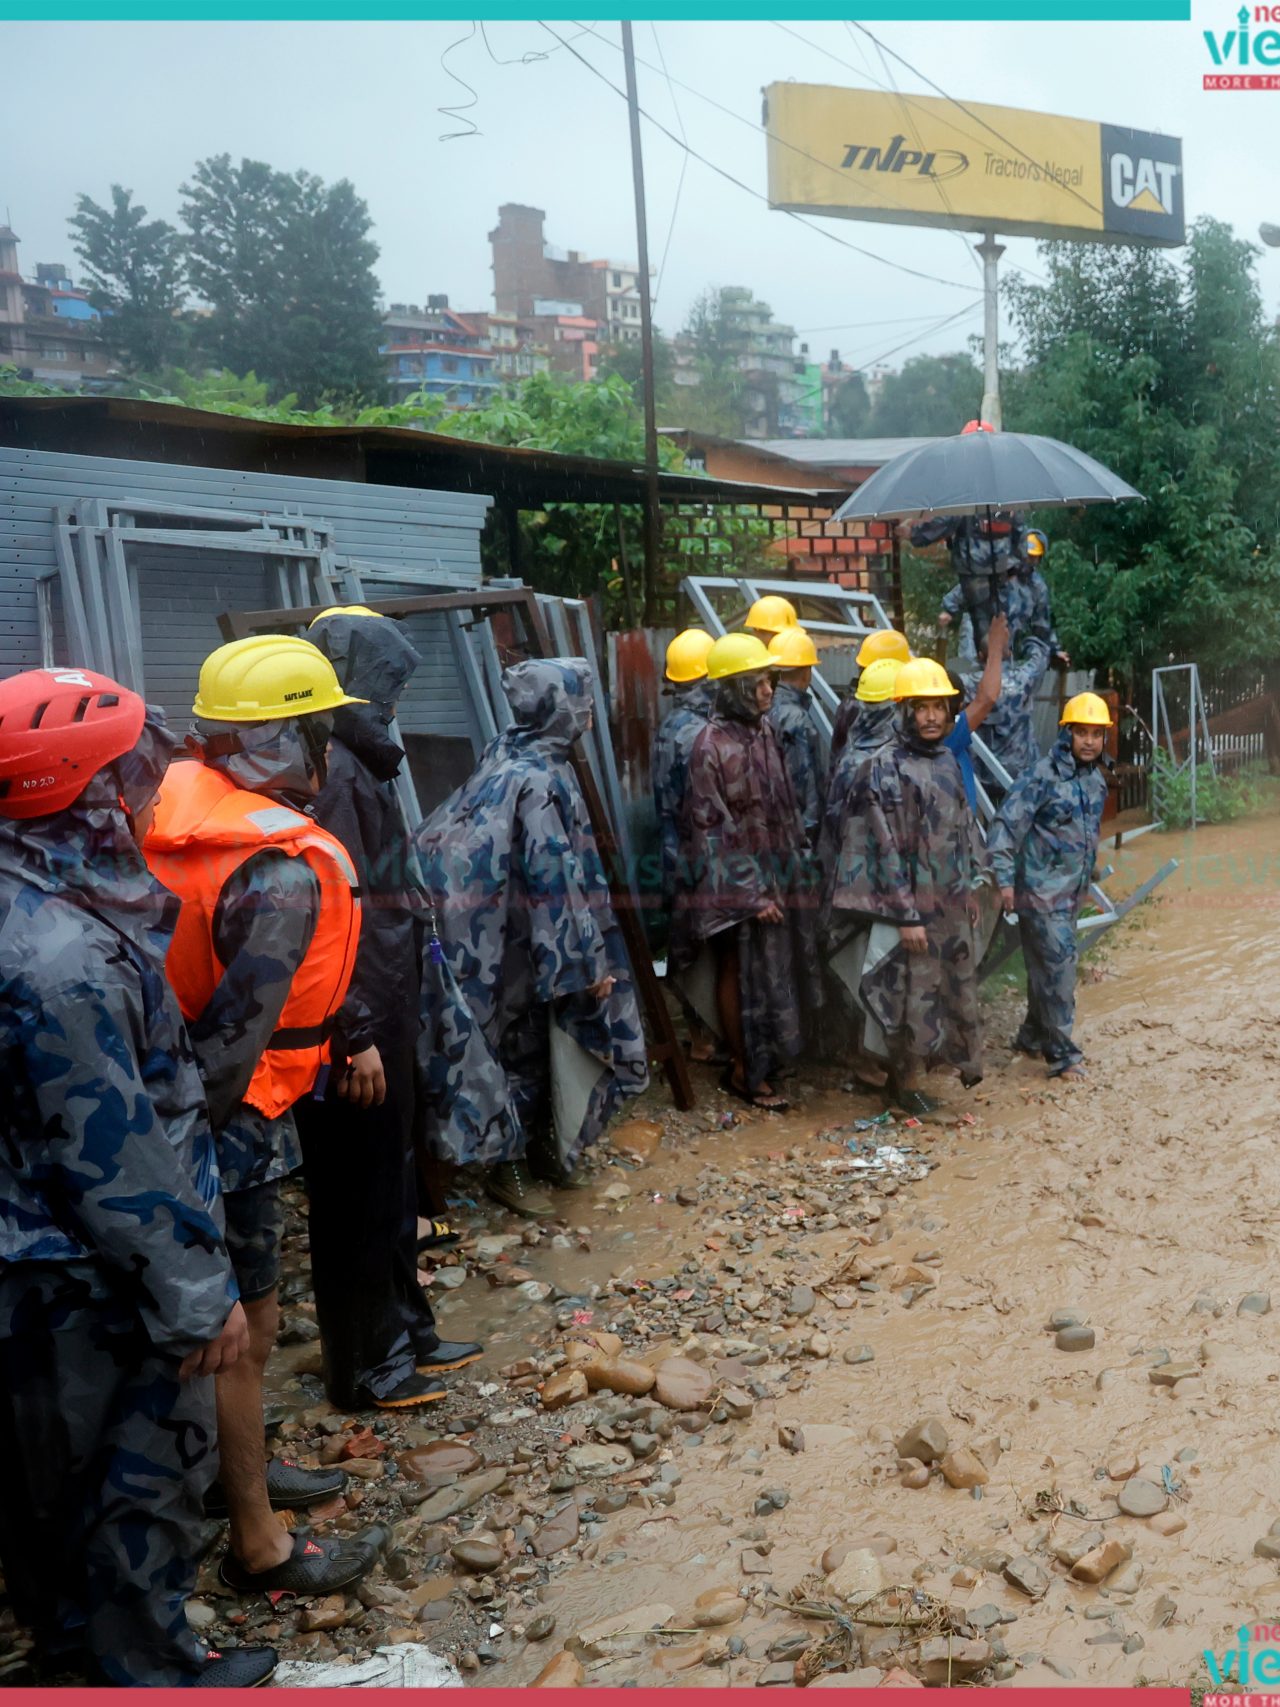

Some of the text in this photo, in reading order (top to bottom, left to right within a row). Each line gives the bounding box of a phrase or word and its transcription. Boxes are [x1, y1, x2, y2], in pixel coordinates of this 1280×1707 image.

[841, 134, 937, 176] TNPL
[984, 152, 1083, 189] Tractors Nepal
[1110, 153, 1177, 215] CAT
